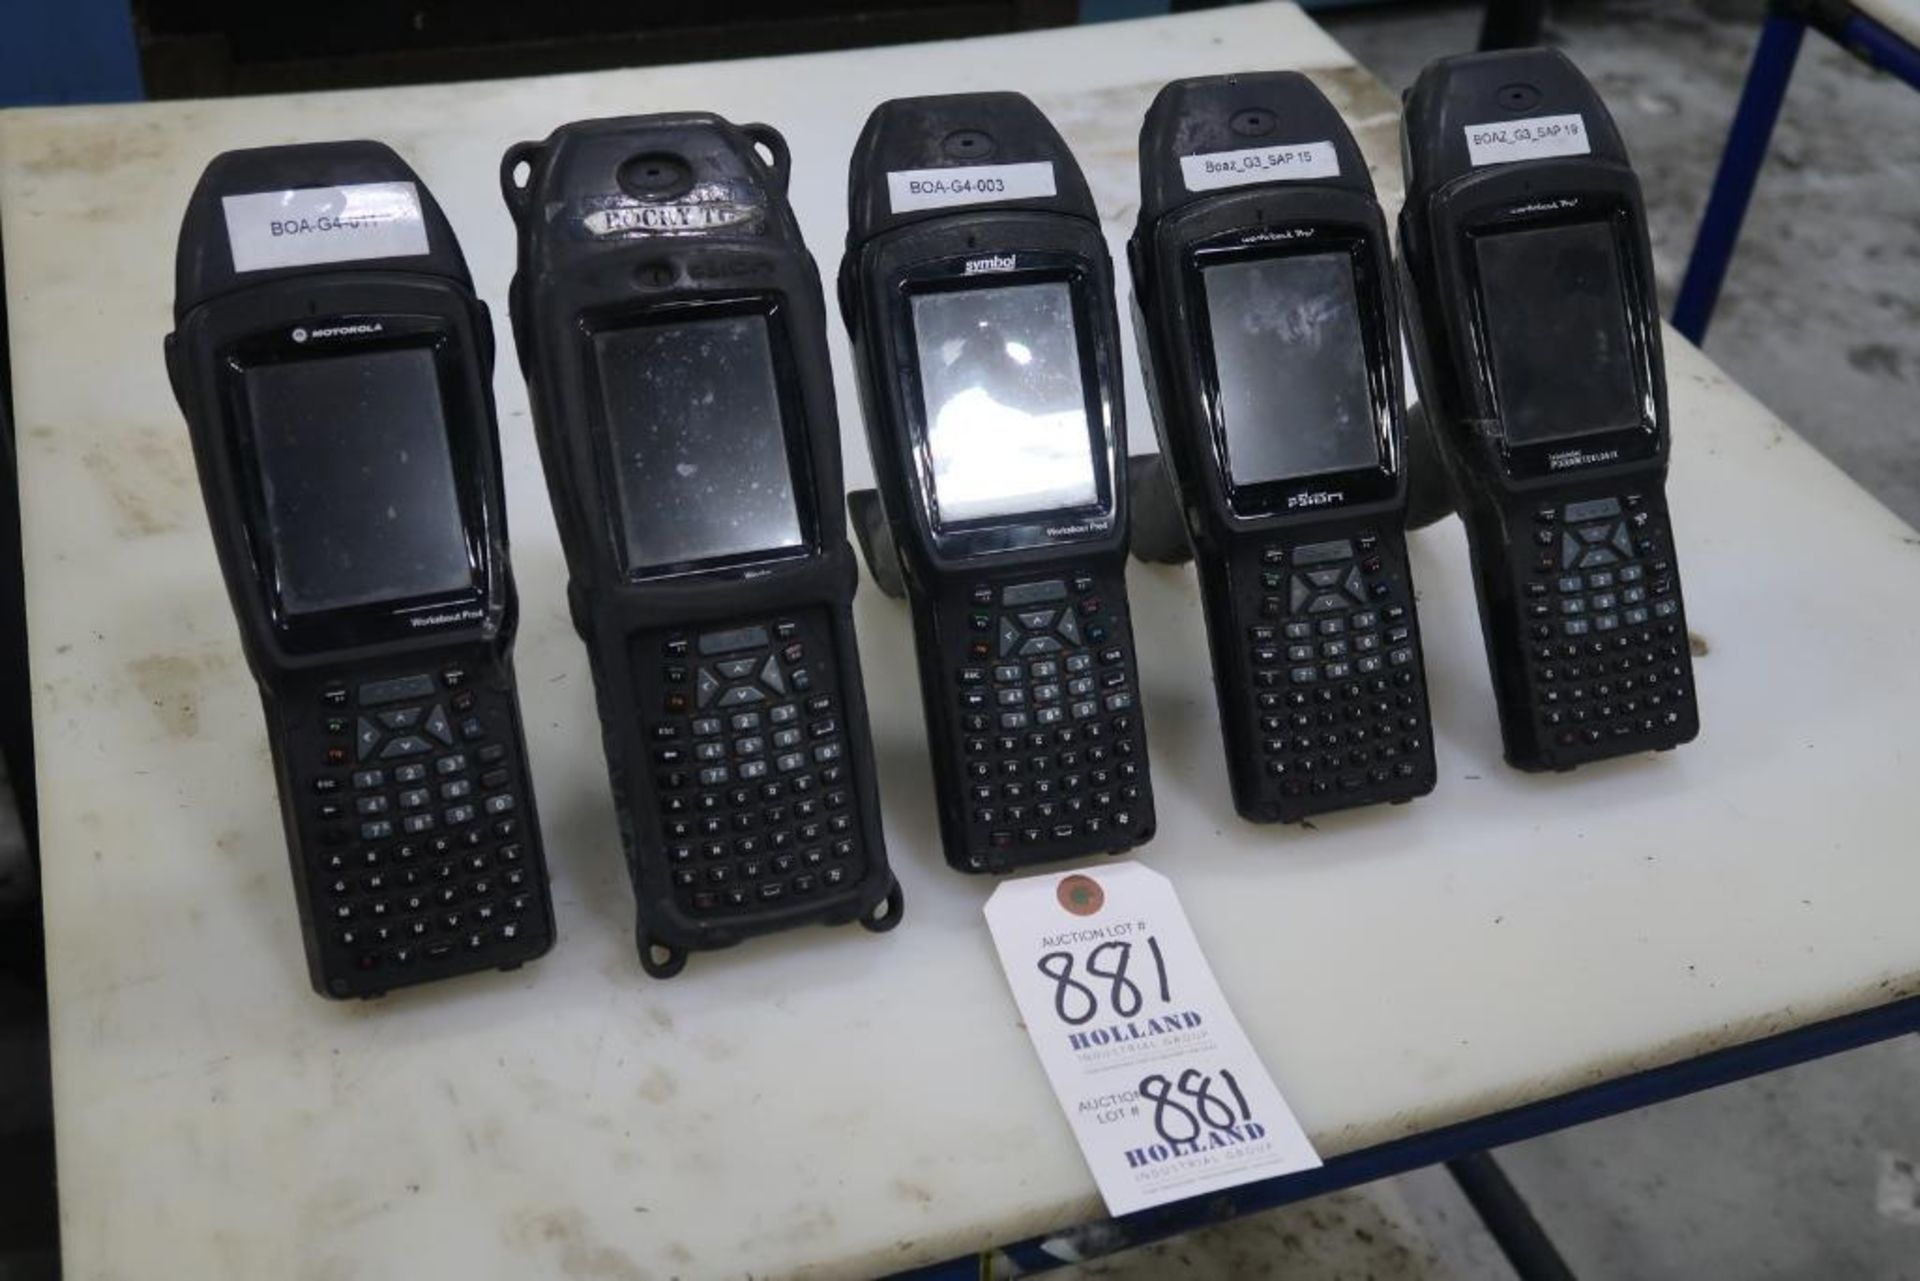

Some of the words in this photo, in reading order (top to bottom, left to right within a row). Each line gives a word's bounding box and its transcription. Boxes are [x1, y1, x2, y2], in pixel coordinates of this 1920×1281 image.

[1299, 151, 1312, 163] 15
[910, 178, 1005, 194] BOA-G4-003
[965, 254, 1016, 273] symbol
[312, 323, 383, 338] MOTOROLA
[1043, 926, 1105, 948] AUCTION
[1107, 923, 1133, 938] LOT
[1138, 921, 1146, 931] #
[1037, 936, 1171, 1026] 881
[1068, 1011, 1202, 1050] HOLLAND
[1097, 1109, 1125, 1124] LOT
[1131, 1107, 1140, 1117] #
[1139, 1068, 1252, 1143] 881
[1125, 1122, 1266, 1168] HOLLAND
